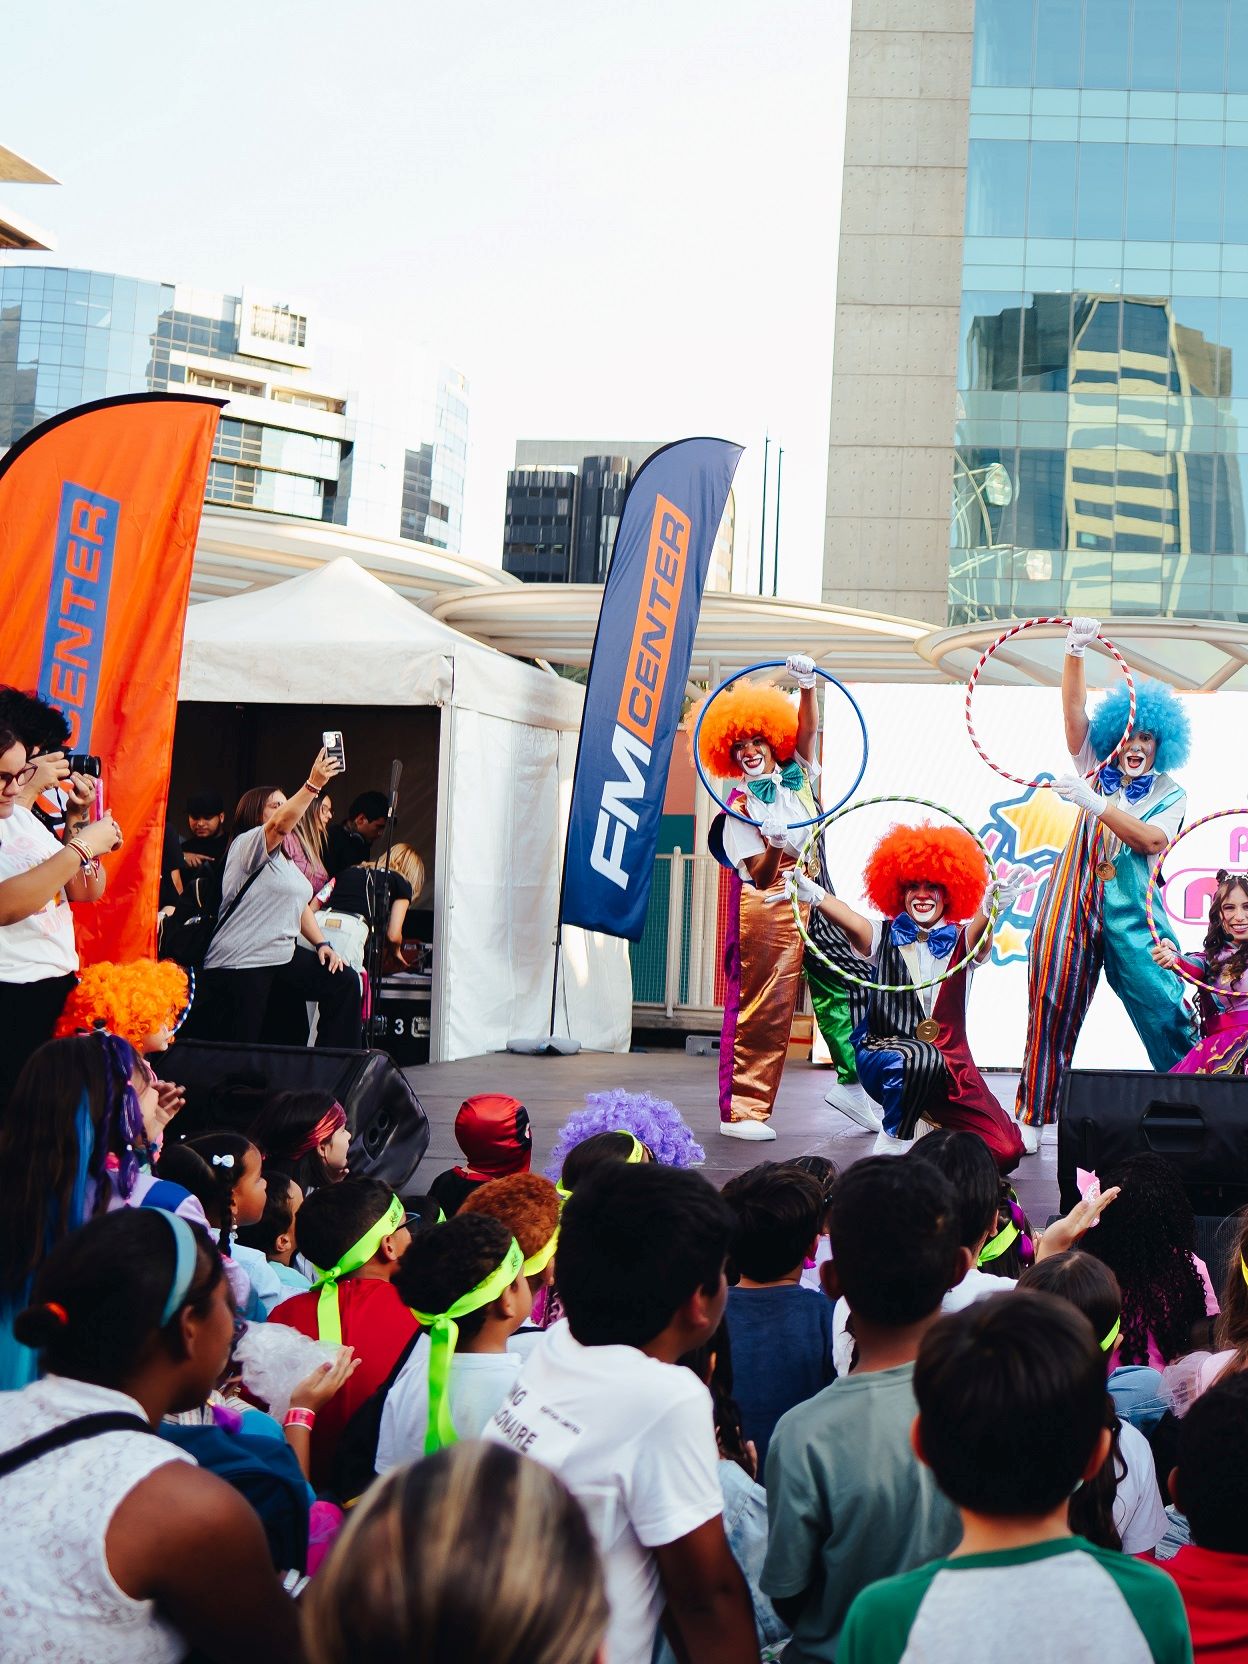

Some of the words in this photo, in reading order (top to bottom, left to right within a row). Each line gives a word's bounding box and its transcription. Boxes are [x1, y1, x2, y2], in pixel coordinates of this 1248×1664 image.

[590, 724, 652, 891] FM
[628, 511, 685, 729] CENTER
[394, 1018, 405, 1035] 3
